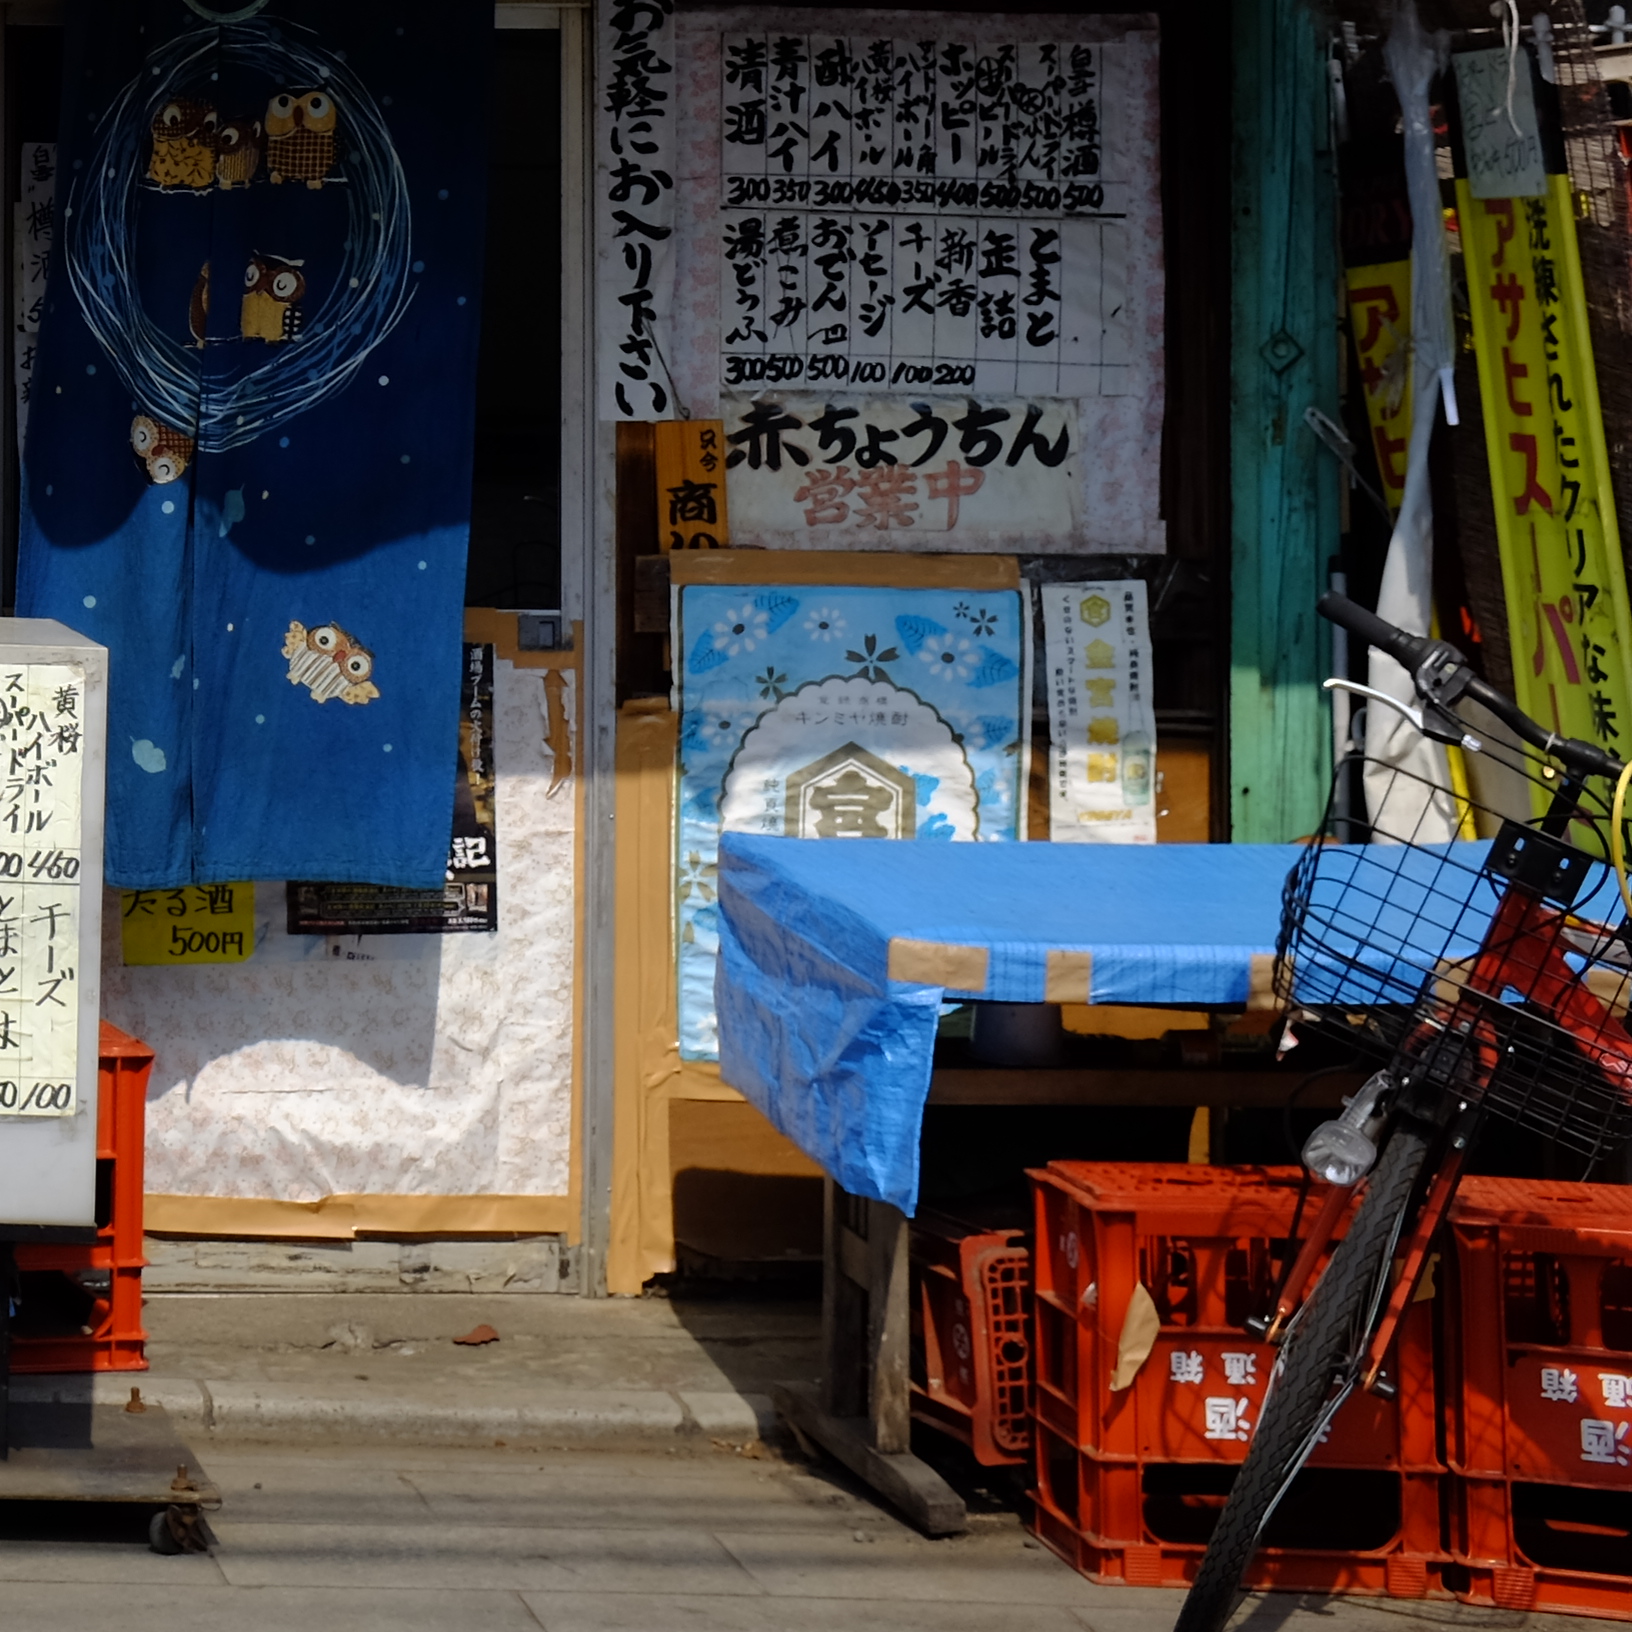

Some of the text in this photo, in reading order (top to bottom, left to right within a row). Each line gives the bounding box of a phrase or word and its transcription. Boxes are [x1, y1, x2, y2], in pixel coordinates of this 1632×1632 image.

[724, 38, 769, 146] 清酒
[938, 42, 978, 165] ホッピー
[769, 216, 809, 327] 煮こみ
[899, 223, 942, 314] チーズ
[936, 228, 978, 318] 新香
[1023, 227, 1062, 347] とまと
[725, 356, 767, 385] 300
[765, 354, 806, 383] 500
[807, 354, 849, 382] 500
[850, 361, 886, 383] 100
[891, 362, 933, 385] 100
[933, 363, 976, 385] 200
[724, 399, 1071, 471] 赤ちょうちん
[792, 459, 988, 532] 営業中
[4, 672, 30, 835] スーパードライ
[49, 684, 81, 756] 黄桜
[795, 711, 909, 727] キンミヤ焼酎
[23, 710, 54, 836] ハイボール
[168, 925, 243, 956] 500円
[19, 1079, 71, 1111] 100
